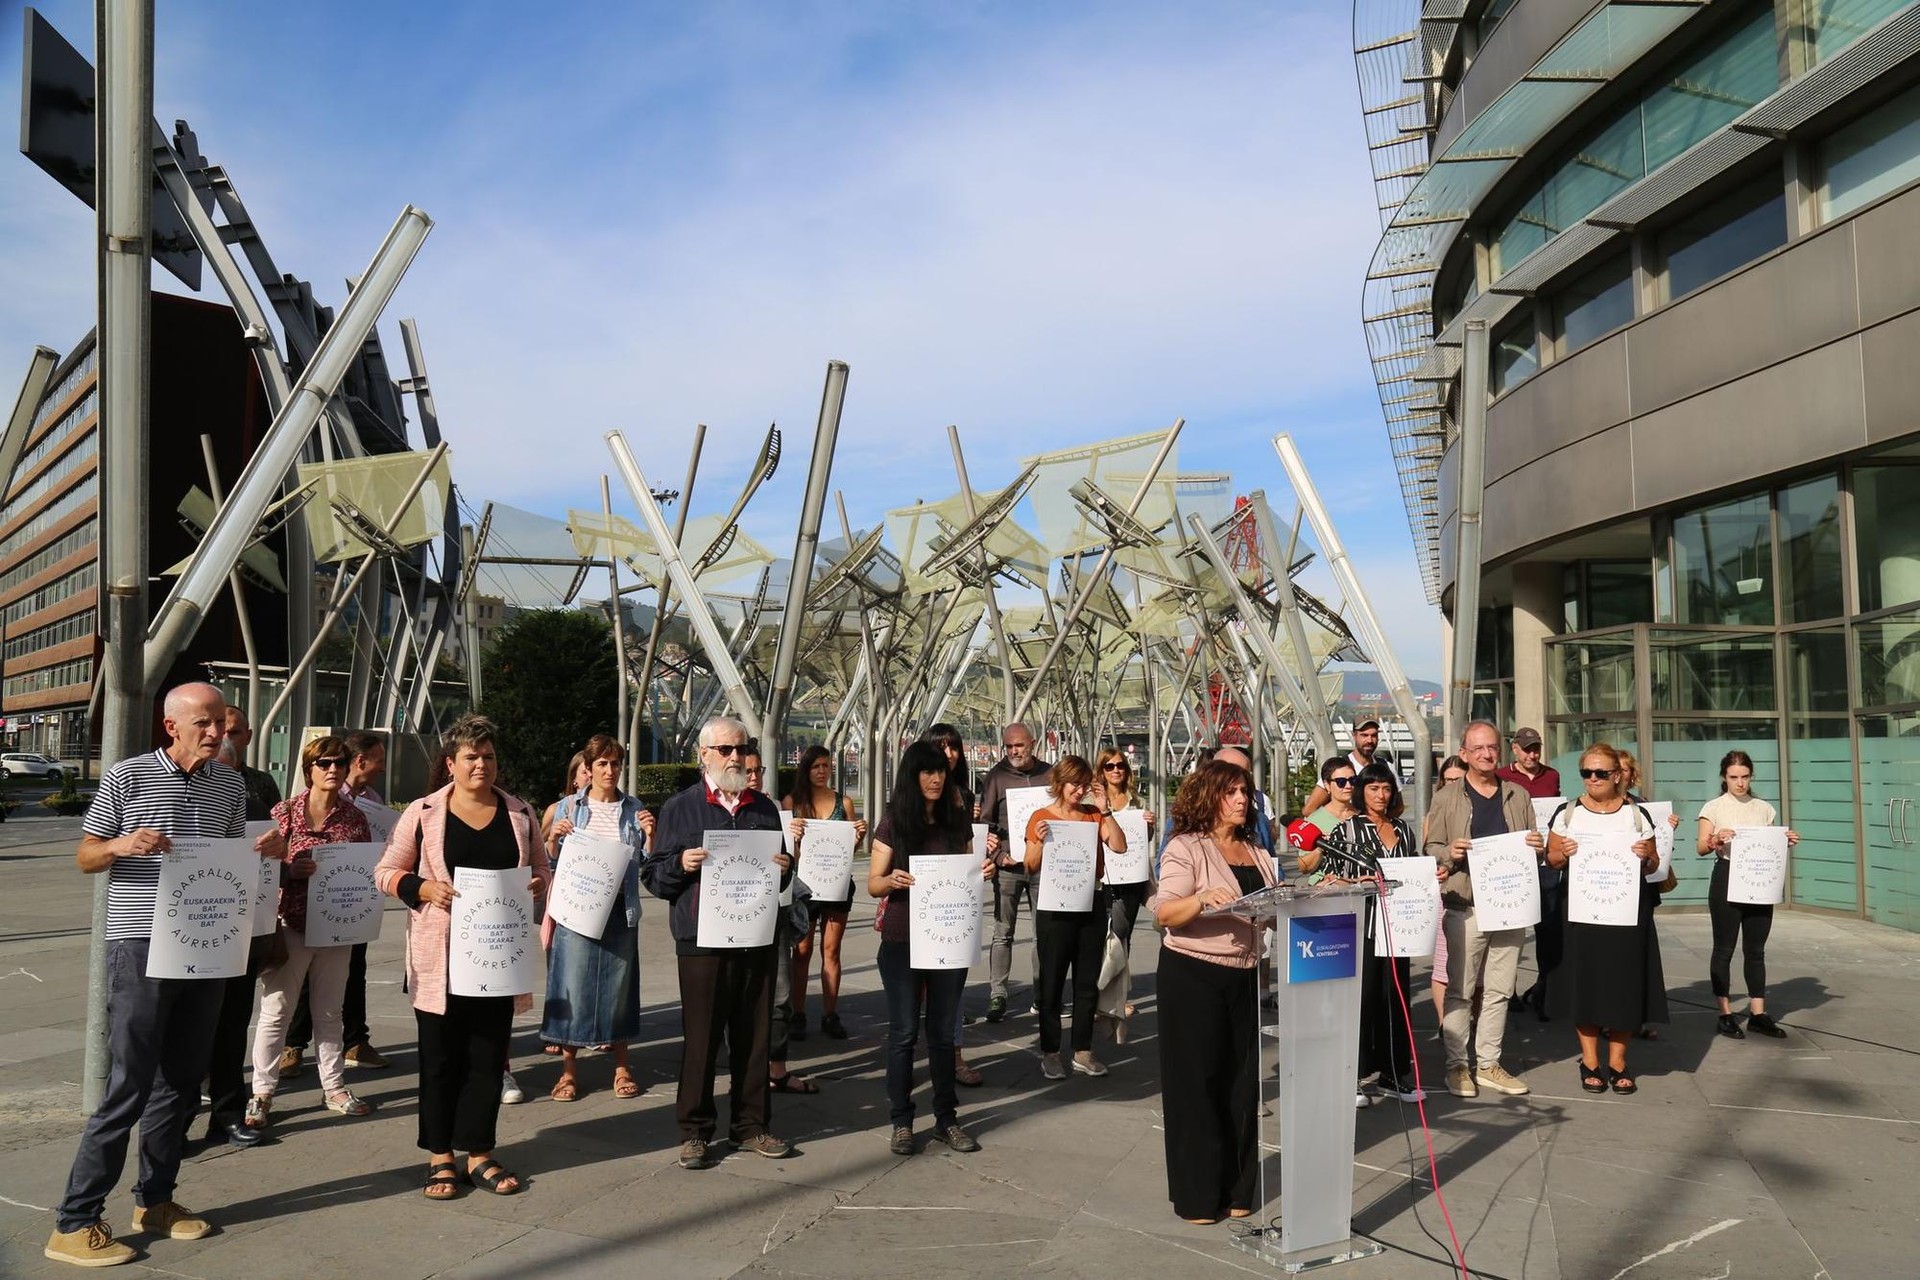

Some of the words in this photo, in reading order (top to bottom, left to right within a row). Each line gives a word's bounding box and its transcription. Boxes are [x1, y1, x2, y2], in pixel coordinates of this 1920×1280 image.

[1048, 840, 1091, 872] OLDARRALDIAREN
[561, 854, 615, 898] OLDARRALDIAREN
[710, 855, 773, 896] OLDARRALDIAREN
[1480, 855, 1533, 892] OLDARRALDIAREN
[1577, 850, 1633, 885] OLDARRALDIAREN
[167, 868, 248, 918] OLDARRALDIAREN
[1051, 877, 1087, 892] AURREAN
[184, 898, 235, 906] EUSKARAEKIN
[560, 888, 602, 912] AURREAN
[919, 879, 979, 919] OLDARRALDIAREN
[1486, 892, 1531, 909] AURREAN
[1581, 889, 1628, 905] AURREAN
[188, 912, 229, 920] EUSKARAZ
[202, 905, 217, 913] BAT
[320, 907, 372, 924] AURREAN
[461, 897, 528, 940] OLDARRALDIAREN
[714, 903, 767, 922] AURREAN
[473, 922, 519, 930] EUSKARAEKIN
[924, 925, 974, 944] AURREAN
[1390, 920, 1431, 935] AURREAN
[171, 926, 239, 949] AURREAN
[478, 936, 515, 944] EUSKARAZ
[465, 948, 525, 970] AURREAN
